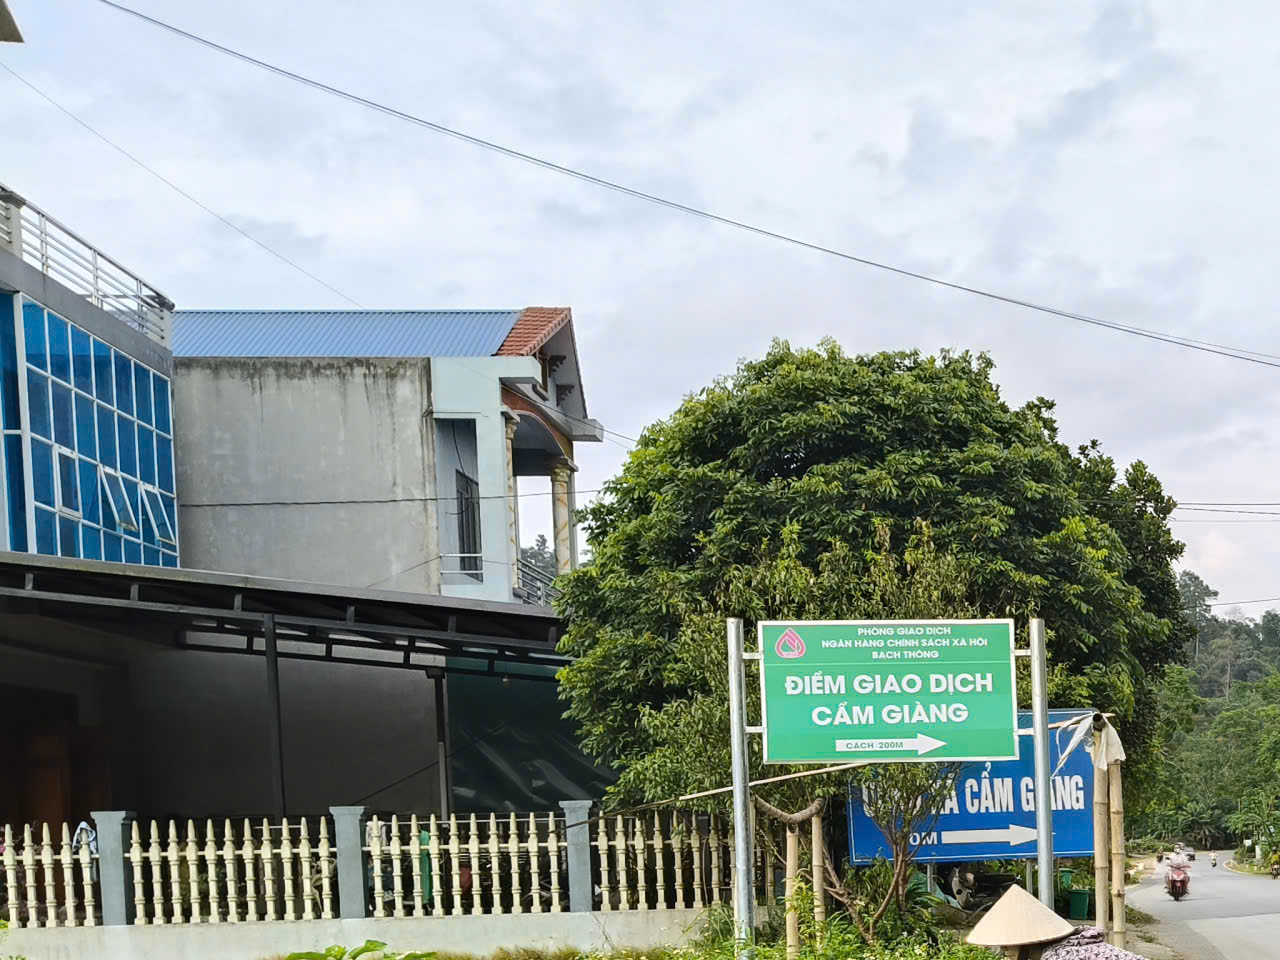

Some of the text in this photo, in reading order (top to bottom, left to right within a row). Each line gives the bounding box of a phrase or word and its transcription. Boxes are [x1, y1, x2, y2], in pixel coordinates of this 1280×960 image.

[857, 626, 894, 636] PHÒNG
[896, 627, 924, 636] GIAO
[853, 638, 885, 648] HÀNG
[887, 638, 919, 648] CHÍNH
[921, 637, 950, 647] SÁCH
[903, 649, 939, 659] THÔNG
[784, 671, 993, 696] ĐIỂM GIAO DỊCH
[811, 701, 969, 726] CẨM GIÀNG
[878, 741, 904, 749] 200M
[965, 762, 1015, 814] CẨM
[1020, 775, 1085, 812] GNG
